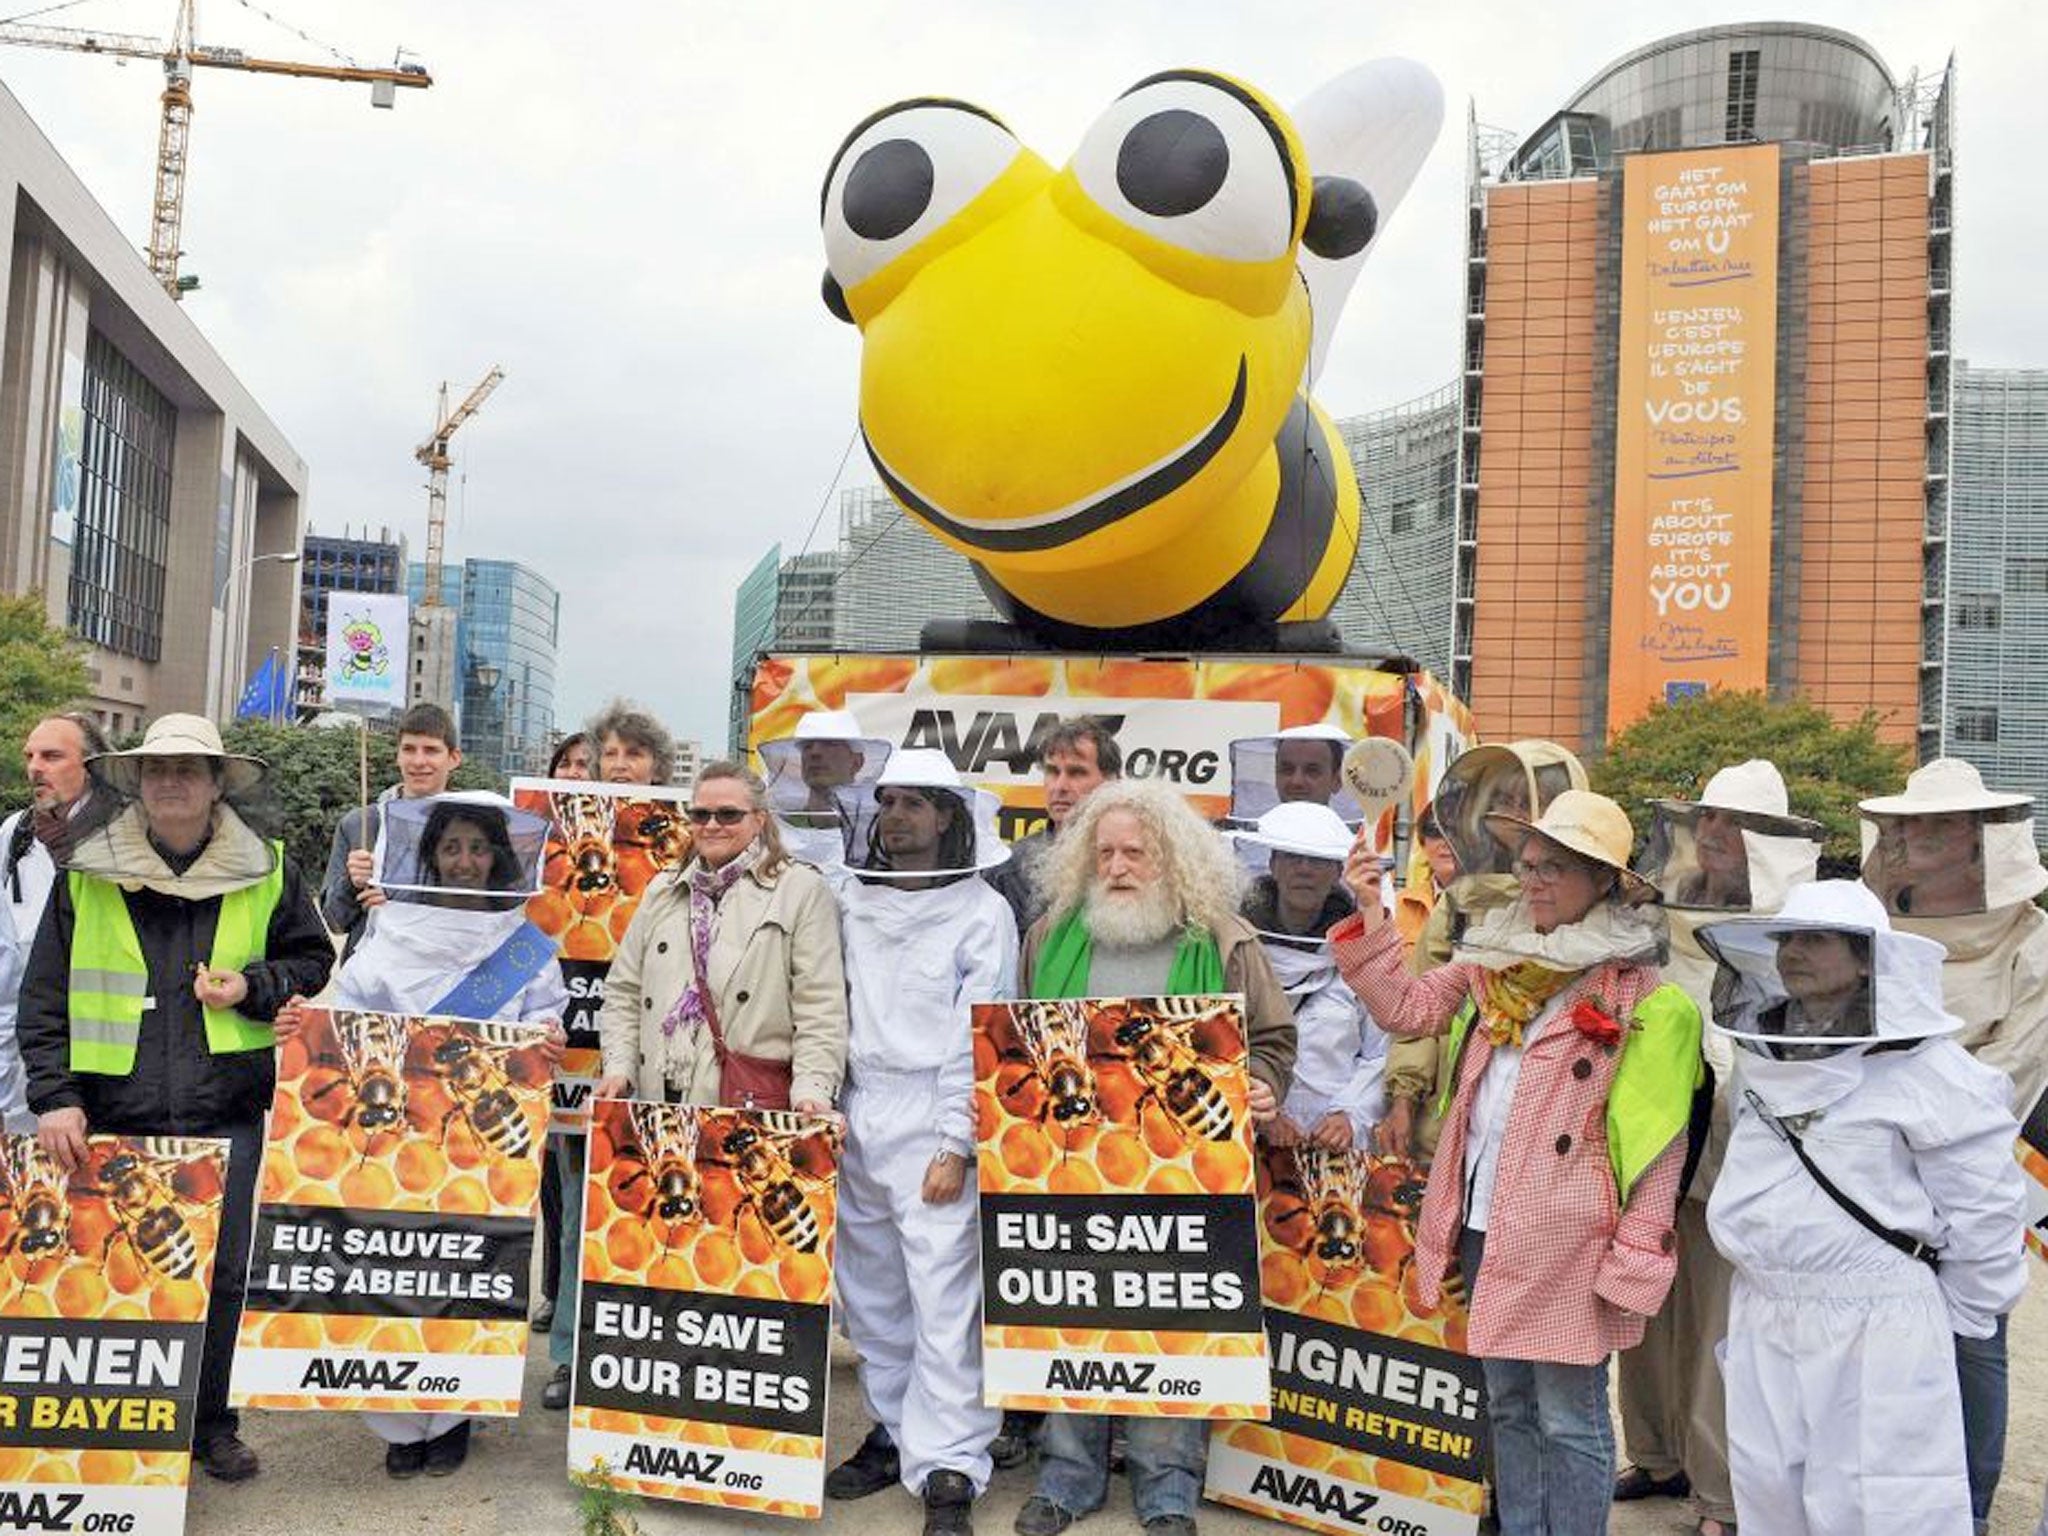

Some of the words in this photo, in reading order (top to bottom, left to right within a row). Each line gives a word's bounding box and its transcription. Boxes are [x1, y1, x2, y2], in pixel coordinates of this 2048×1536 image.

[1679, 167, 1723, 182] HET
[1654, 185, 1708, 200] GAAT
[1715, 182, 1747, 195] OM
[1660, 200, 1740, 215] EUROPA
[1648, 217, 1691, 234] HET
[1696, 213, 1752, 229] GAAT
[1668, 238, 1701, 251] OM
[1706, 231, 1730, 255] U
[1650, 362, 1667, 377] IL
[1682, 381, 1711, 396] DE
[1645, 398, 1742, 424] VOUS
[1671, 498, 1714, 513] IT'S
[1652, 514, 1733, 529] ABOUT
[1648, 531, 1734, 546] EUROPE
[1669, 548, 1711, 562] IT'S
[1650, 563, 1730, 579] ABOUT
[1650, 582, 1732, 616] YOU
[272, 1224, 331, 1253] EU:
[343, 1228, 484, 1261] SAUVEZ
[994, 1212, 1072, 1250] EU:
[1085, 1214, 1209, 1253] SAVE
[266, 1264, 336, 1293] LES
[342, 1268, 513, 1300] ABEILLES
[997, 1268, 1098, 1307] OUR
[1112, 1269, 1244, 1311] BEES
[594, 1301, 664, 1341] EU:
[676, 1310, 785, 1356] SAVE
[0, 1336, 185, 1387] ENEN
[590, 1354, 681, 1398] OUR
[694, 1365, 810, 1414] BEES
[1271, 1332, 1480, 1421] IGNER:
[31, 1396, 177, 1432] BAYER
[1345, 1406, 1473, 1460] RETTEN!
